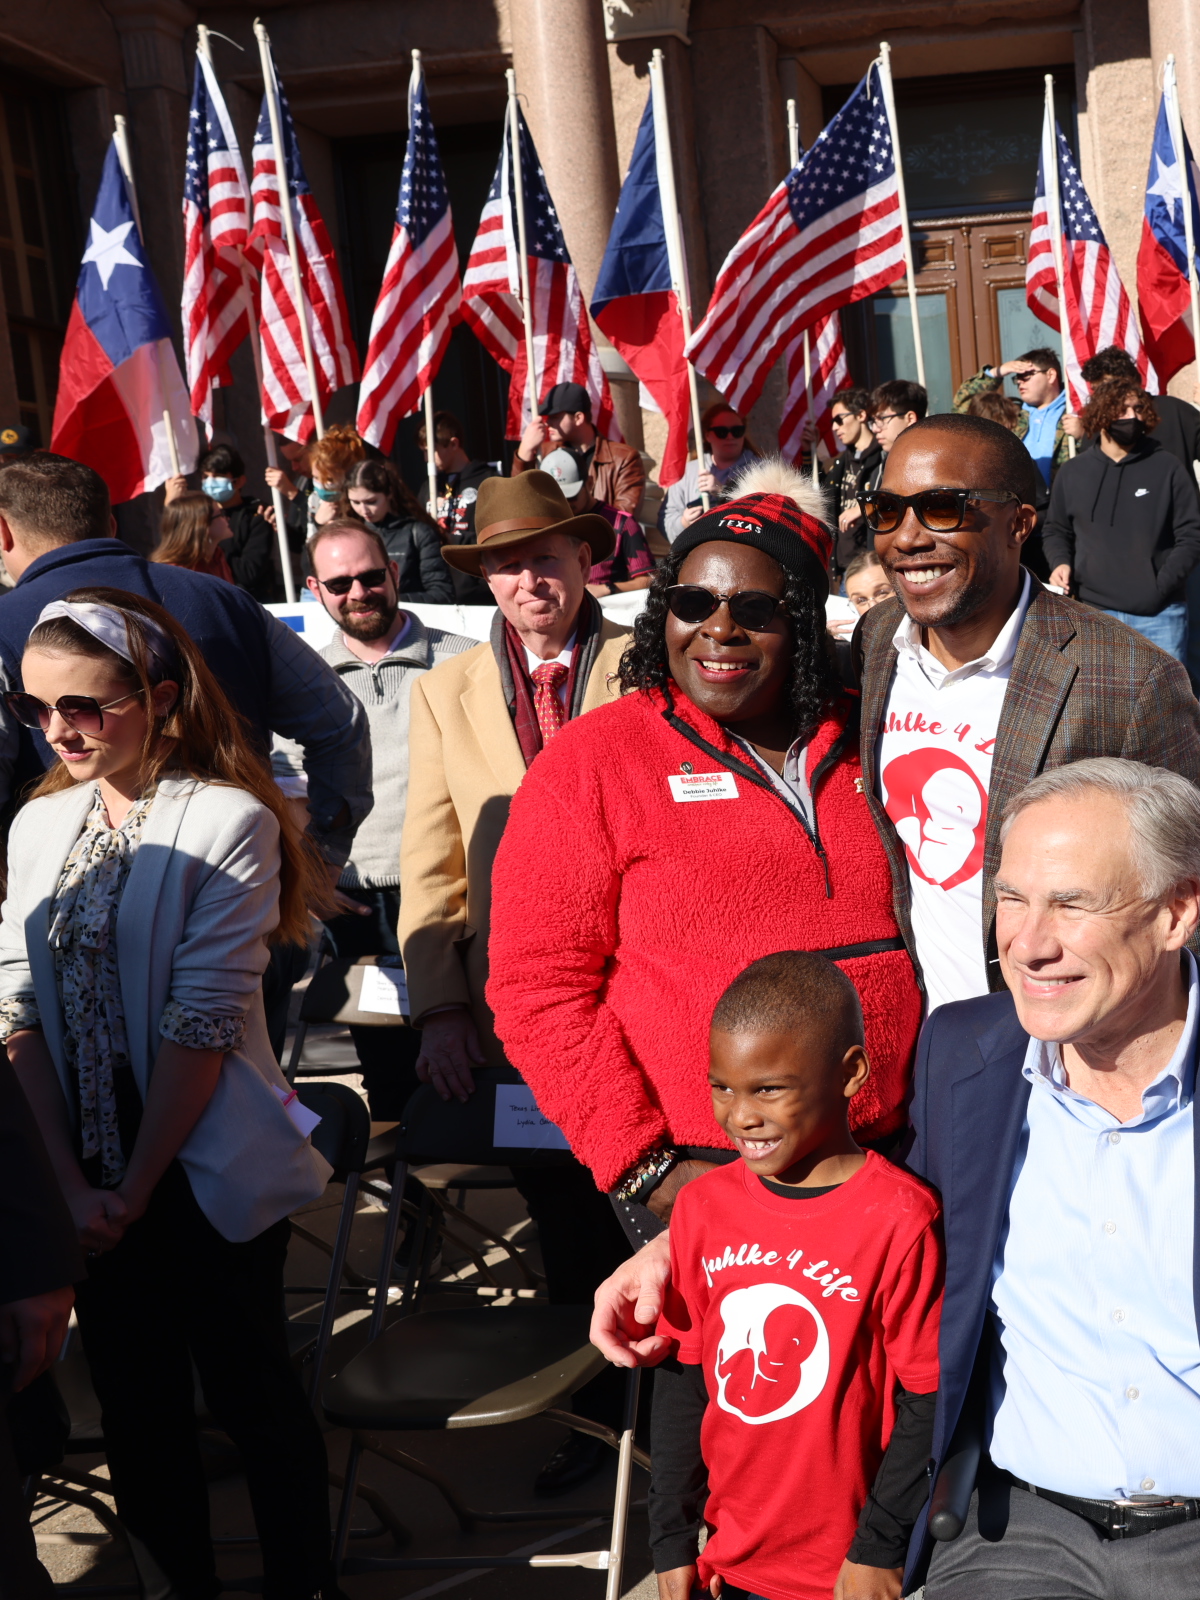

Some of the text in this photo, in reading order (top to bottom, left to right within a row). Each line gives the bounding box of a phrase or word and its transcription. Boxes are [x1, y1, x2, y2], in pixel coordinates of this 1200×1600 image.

[718, 519, 762, 534] TEXAS
[953, 722, 971, 742] 4
[680, 774, 722, 785] EMBRACE
[702, 1243, 861, 1302] Juhlke 4 Life
